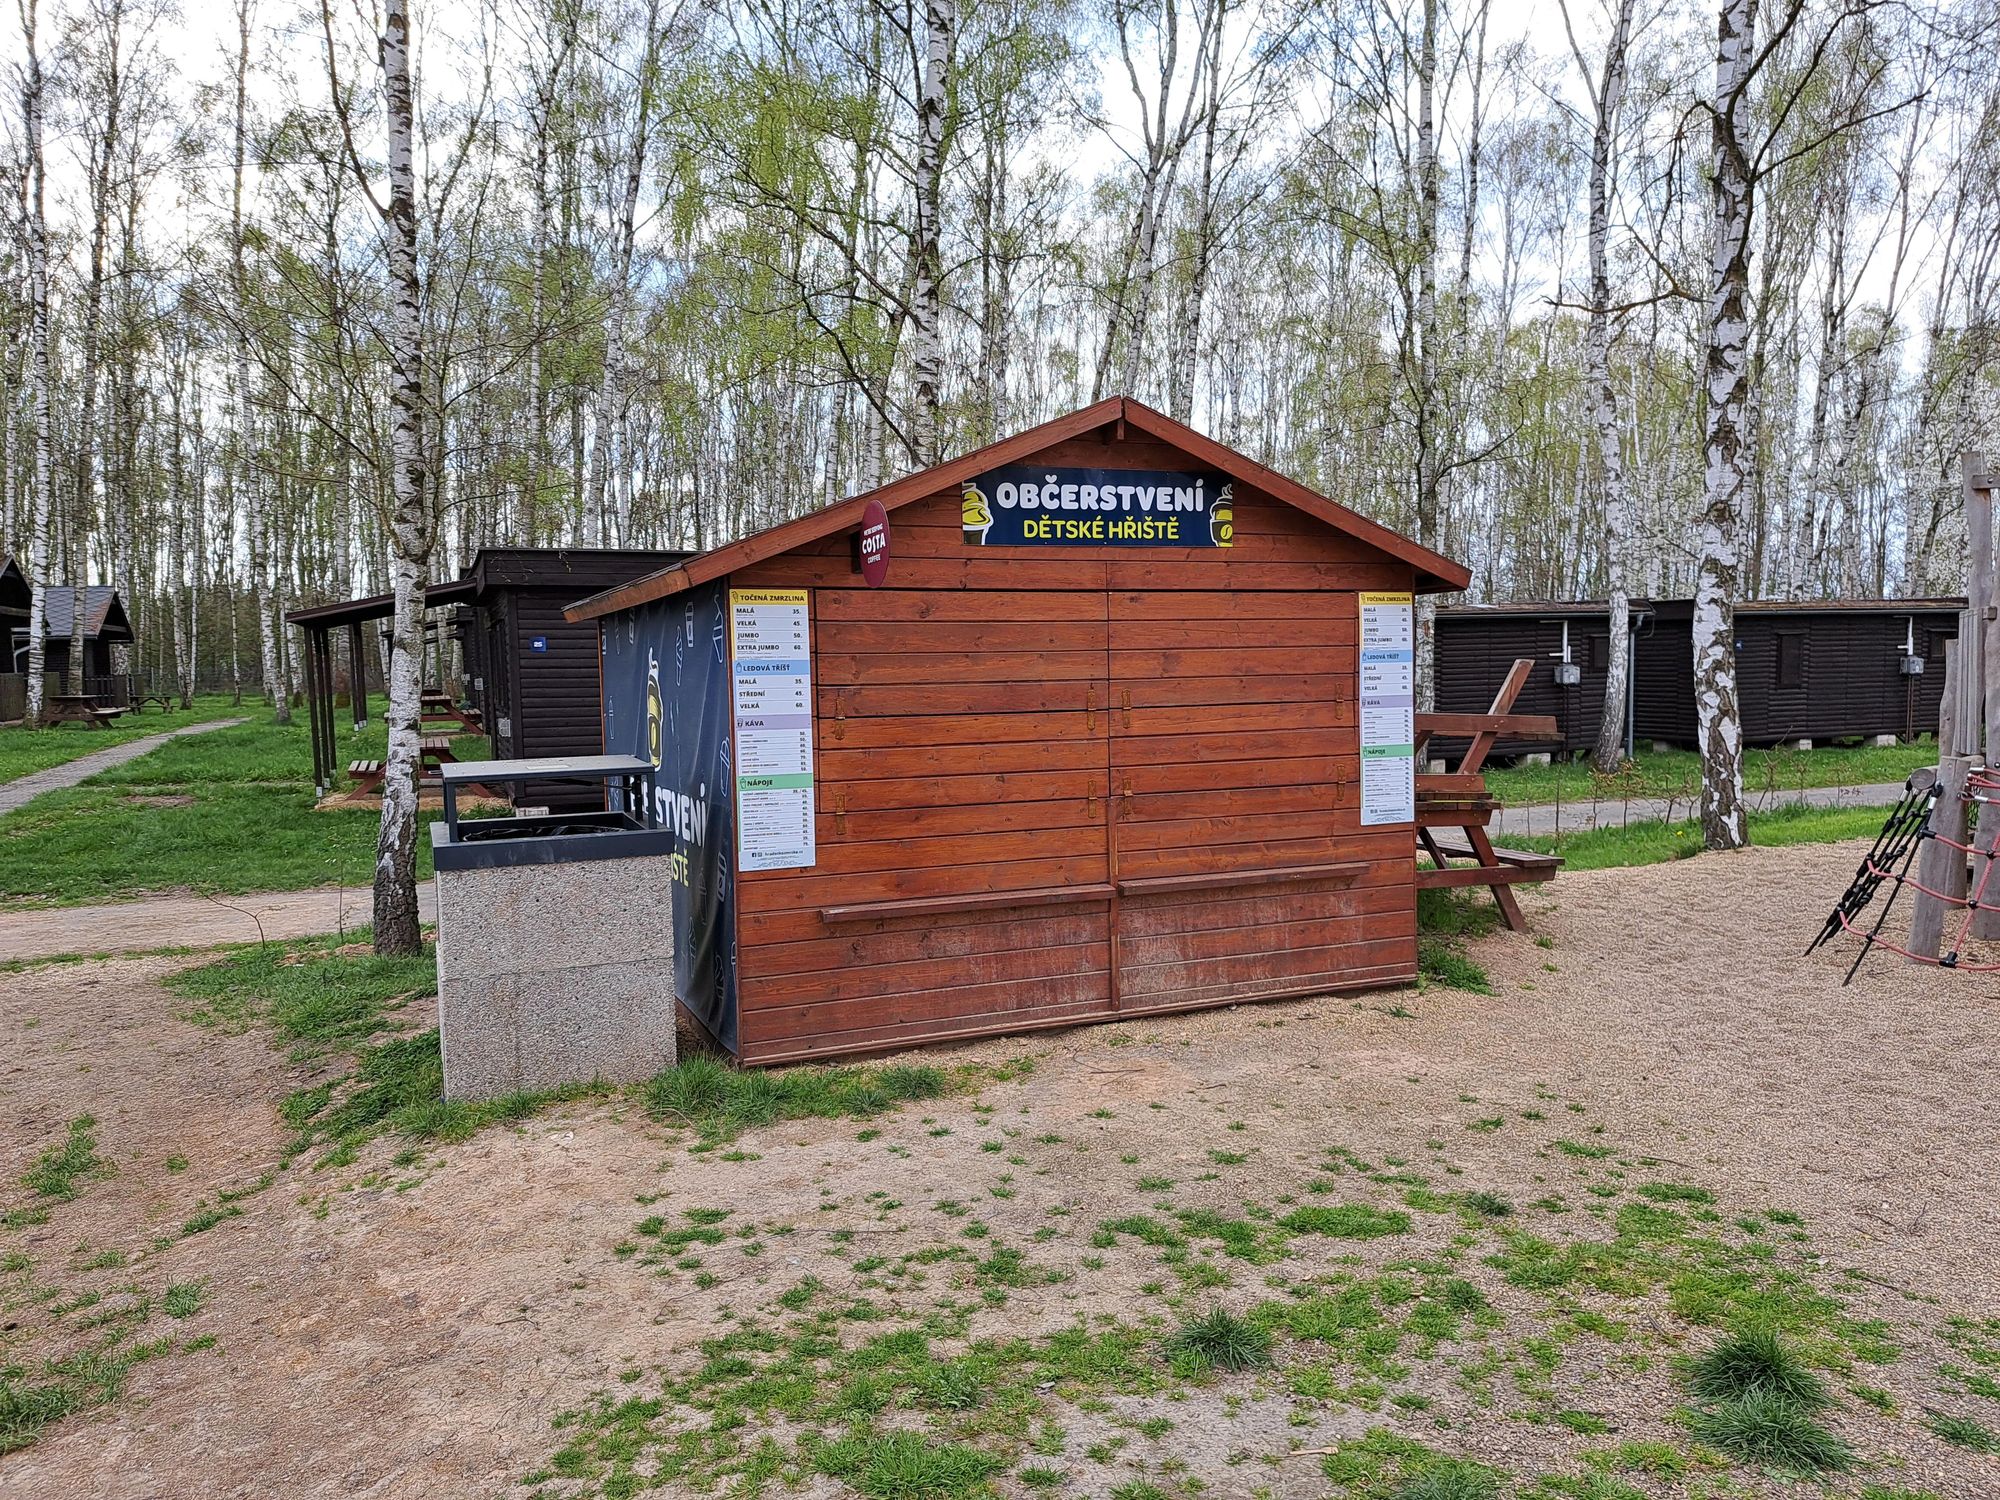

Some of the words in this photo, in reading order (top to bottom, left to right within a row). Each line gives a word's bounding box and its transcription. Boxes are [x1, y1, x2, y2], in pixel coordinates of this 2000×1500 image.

[996, 474, 1204, 512] OBČERSTVENÍ
[1024, 515, 1104, 539] DĚTSKÉ
[1108, 516, 1180, 540] HŘIŠTĚ
[862, 532, 886, 554] COSTA
[868, 554, 880, 564] COFFEE
[772, 663, 790, 671] TŘÍŠŤ
